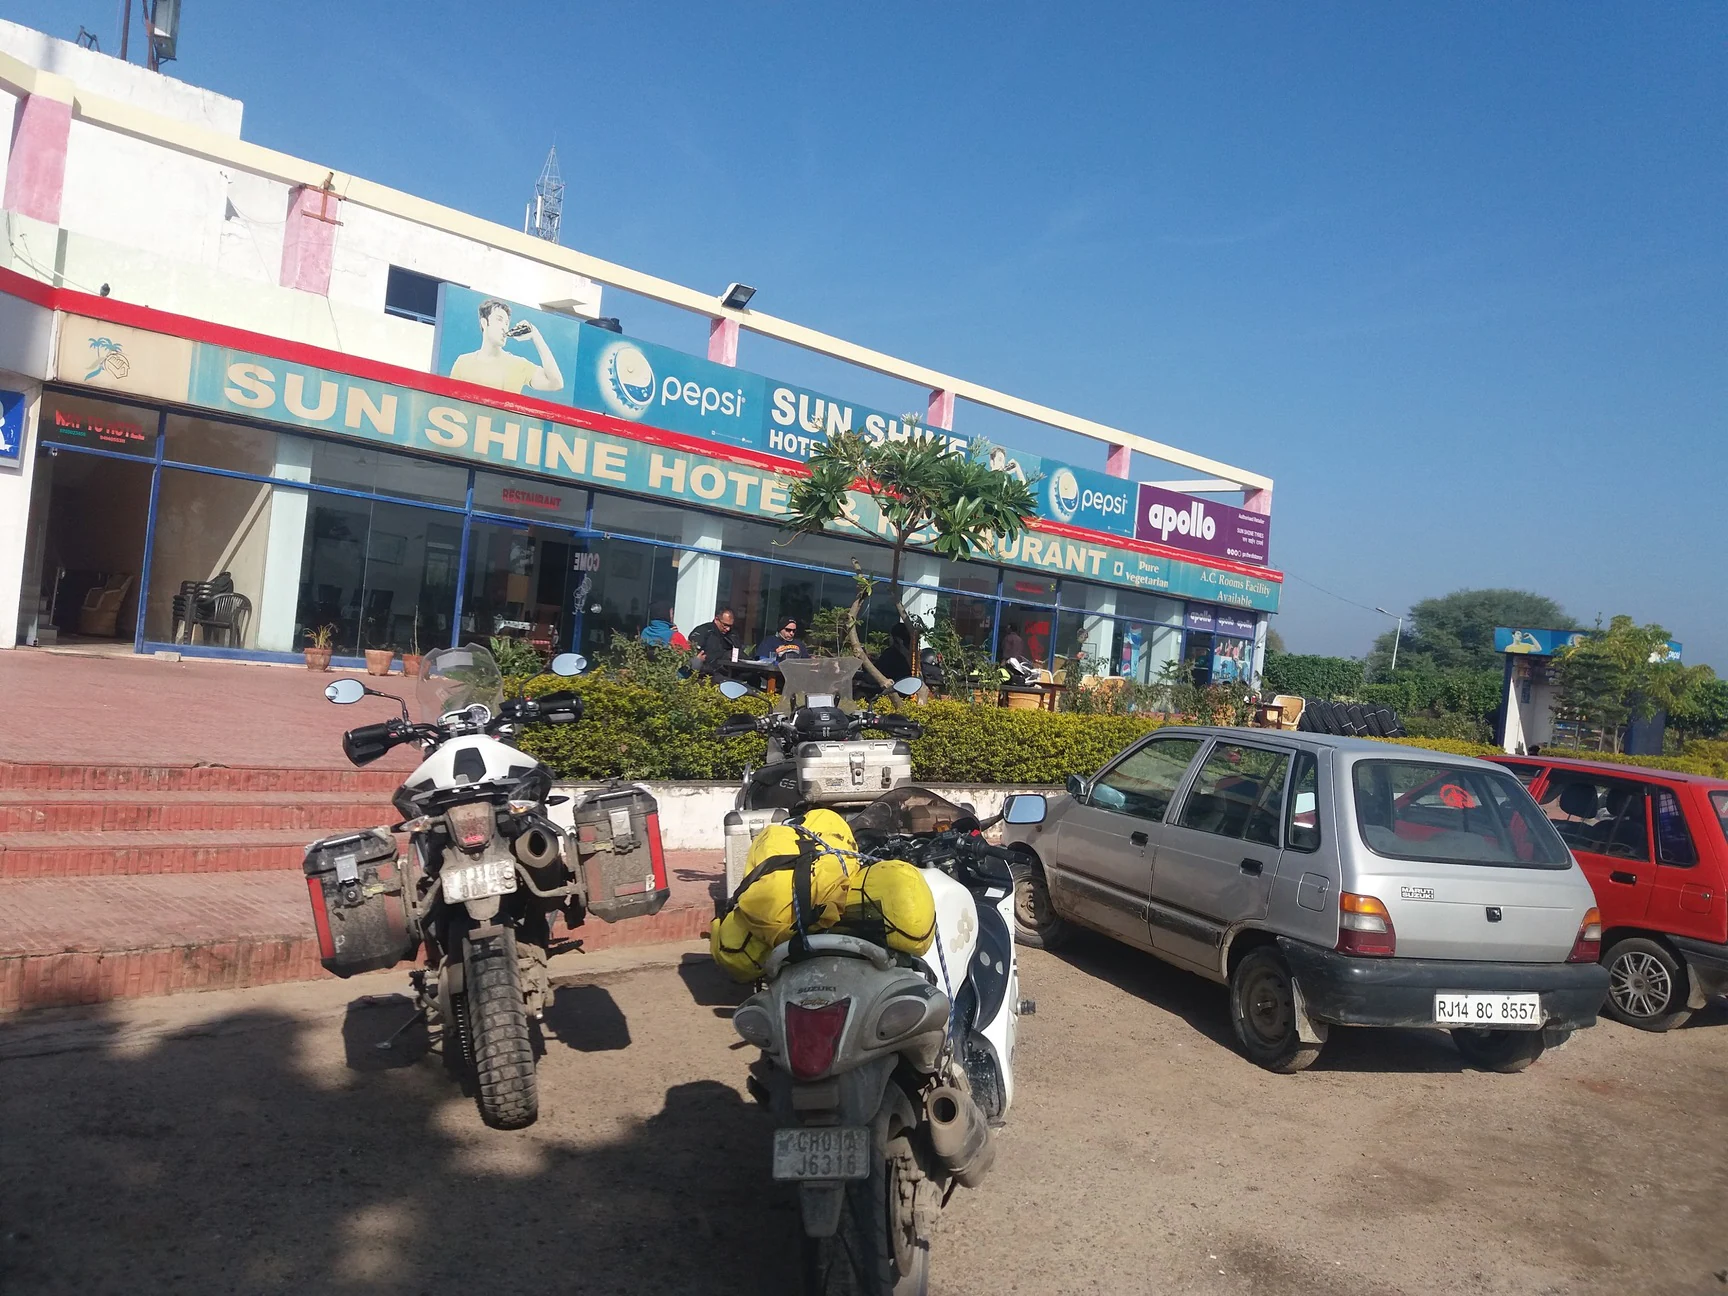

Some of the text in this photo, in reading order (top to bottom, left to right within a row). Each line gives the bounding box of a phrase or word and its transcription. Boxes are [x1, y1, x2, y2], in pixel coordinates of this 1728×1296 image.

[661, 375, 743, 418] pepsi
[771, 387, 852, 438] SUN
[223, 362, 398, 436] SUN
[424, 406, 628, 483] SHINE
[648, 451, 803, 516] HOTE
[769, 429, 828, 457] HOTE
[501, 488, 562, 510] RESTAURANT
[1081, 489, 1127, 516] pepsi
[1148, 502, 1216, 541] apollo
[1125, 571, 1169, 588] Vegetarian
[1138, 561, 1160, 574] Pure
[1200, 571, 1272, 598] A.C. Rooms Facility
[1216, 591, 1253, 607] Available
[1190, 610, 1212, 624] apollo
[796, 985, 837, 995] SUZUKI
[1438, 1001, 1537, 1020] RJ14 8C 8557
